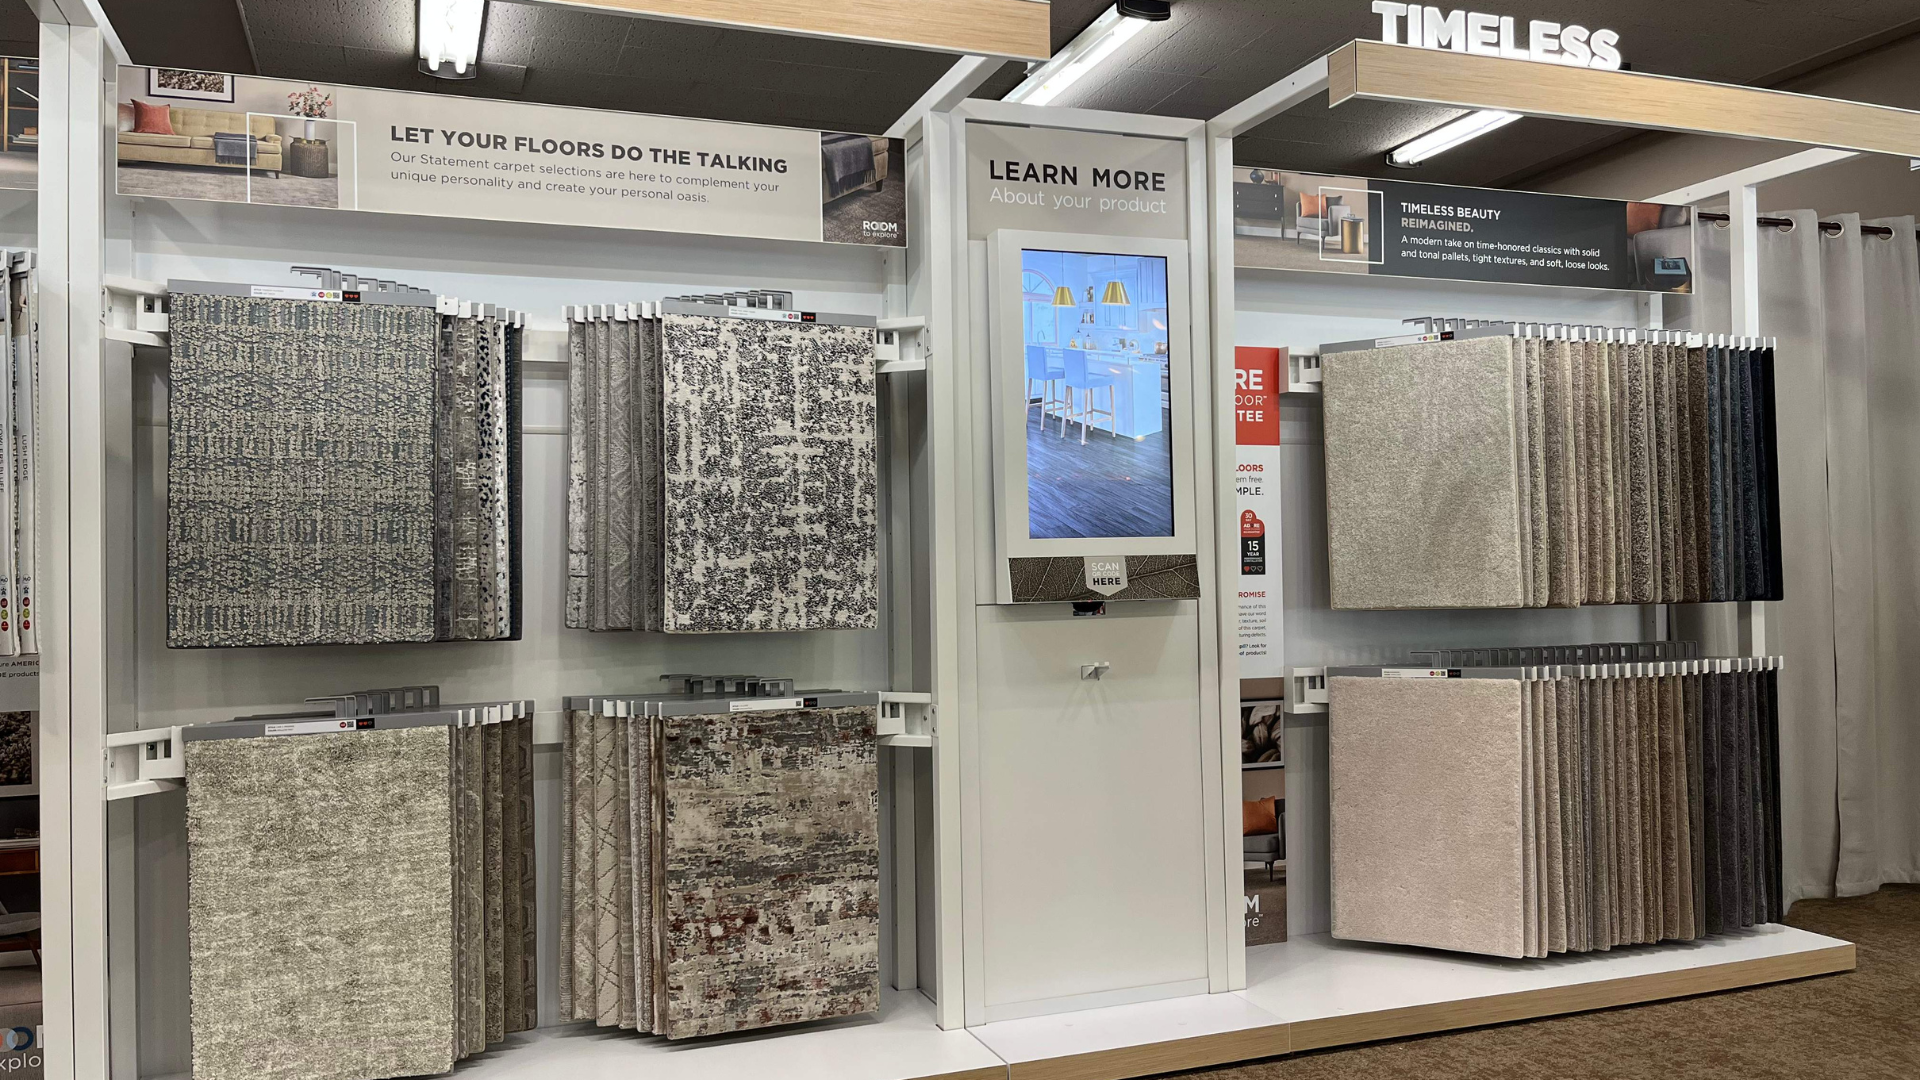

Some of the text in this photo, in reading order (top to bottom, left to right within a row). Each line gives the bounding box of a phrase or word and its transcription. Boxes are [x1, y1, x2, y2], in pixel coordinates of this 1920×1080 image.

[1371, 0, 1621, 71] TIMELESS
[391, 125, 788, 174] LET YOUR FLOORS DO THE TALKING
[390, 151, 780, 193] Our Statement carpet selections are here to complement your
[989, 159, 1166, 192] LEARN MORE
[390, 171, 710, 203] unique personality and create your personal oasis.
[989, 187, 1167, 214] About your product
[1400, 202, 1501, 220] TIMELESS BEAUTY
[863, 220, 898, 232] ROOM
[1401, 217, 1474, 233] REIMAGINED.
[1401, 235, 1600, 257] A modern take on time-honored classics with solid
[1401, 249, 1610, 271] and tonal pallets, tight textures, and soft, loose looks.
[1236, 410, 1264, 422] TEE
[1236, 464, 1264, 472] OORS
[1247, 540, 1259, 551] 15
[1091, 562, 1119, 571] SCAN
[1092, 577, 1121, 586] HERE
